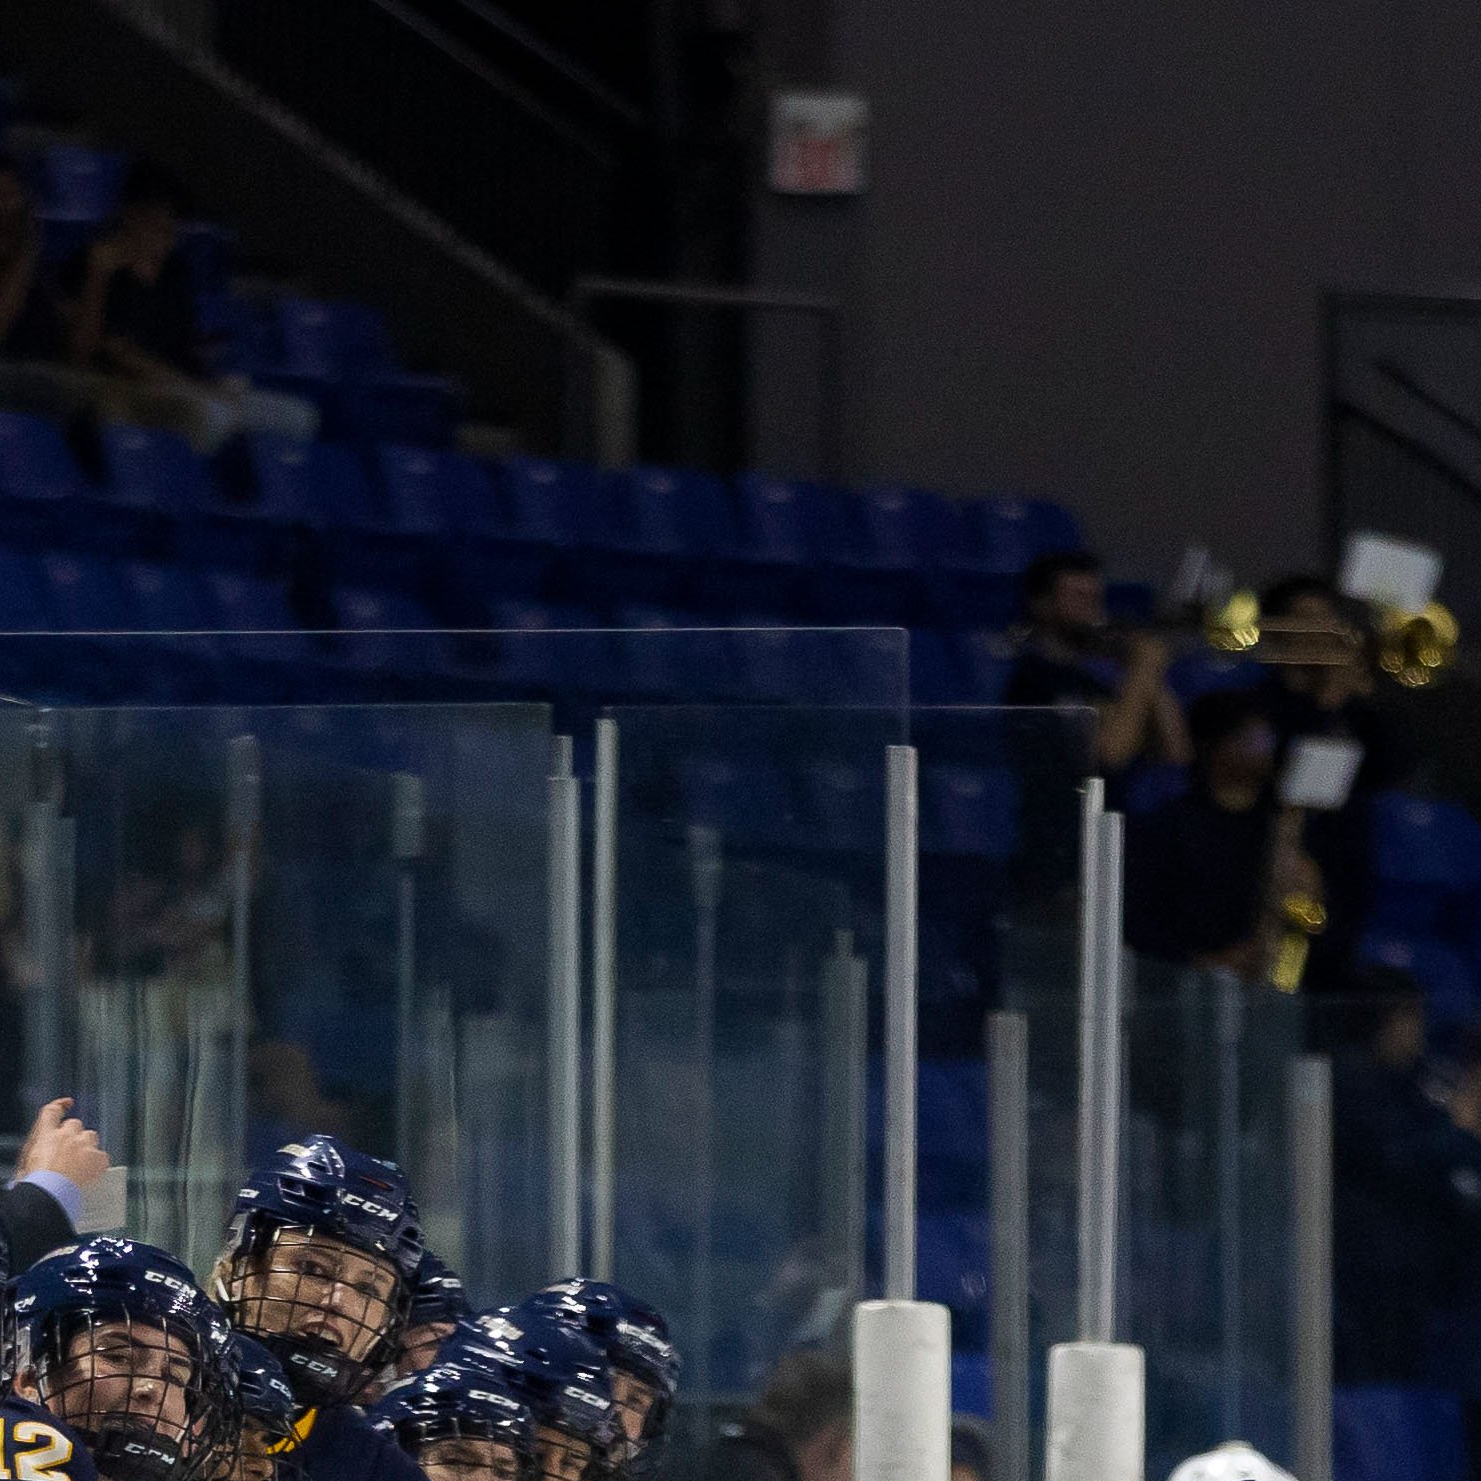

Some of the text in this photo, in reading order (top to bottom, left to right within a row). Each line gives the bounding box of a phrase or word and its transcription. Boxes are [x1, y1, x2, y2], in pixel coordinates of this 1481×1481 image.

[343, 1192, 399, 1222] CCM
[143, 1269, 199, 1300] CCM
[290, 1353, 339, 1378] CCM
